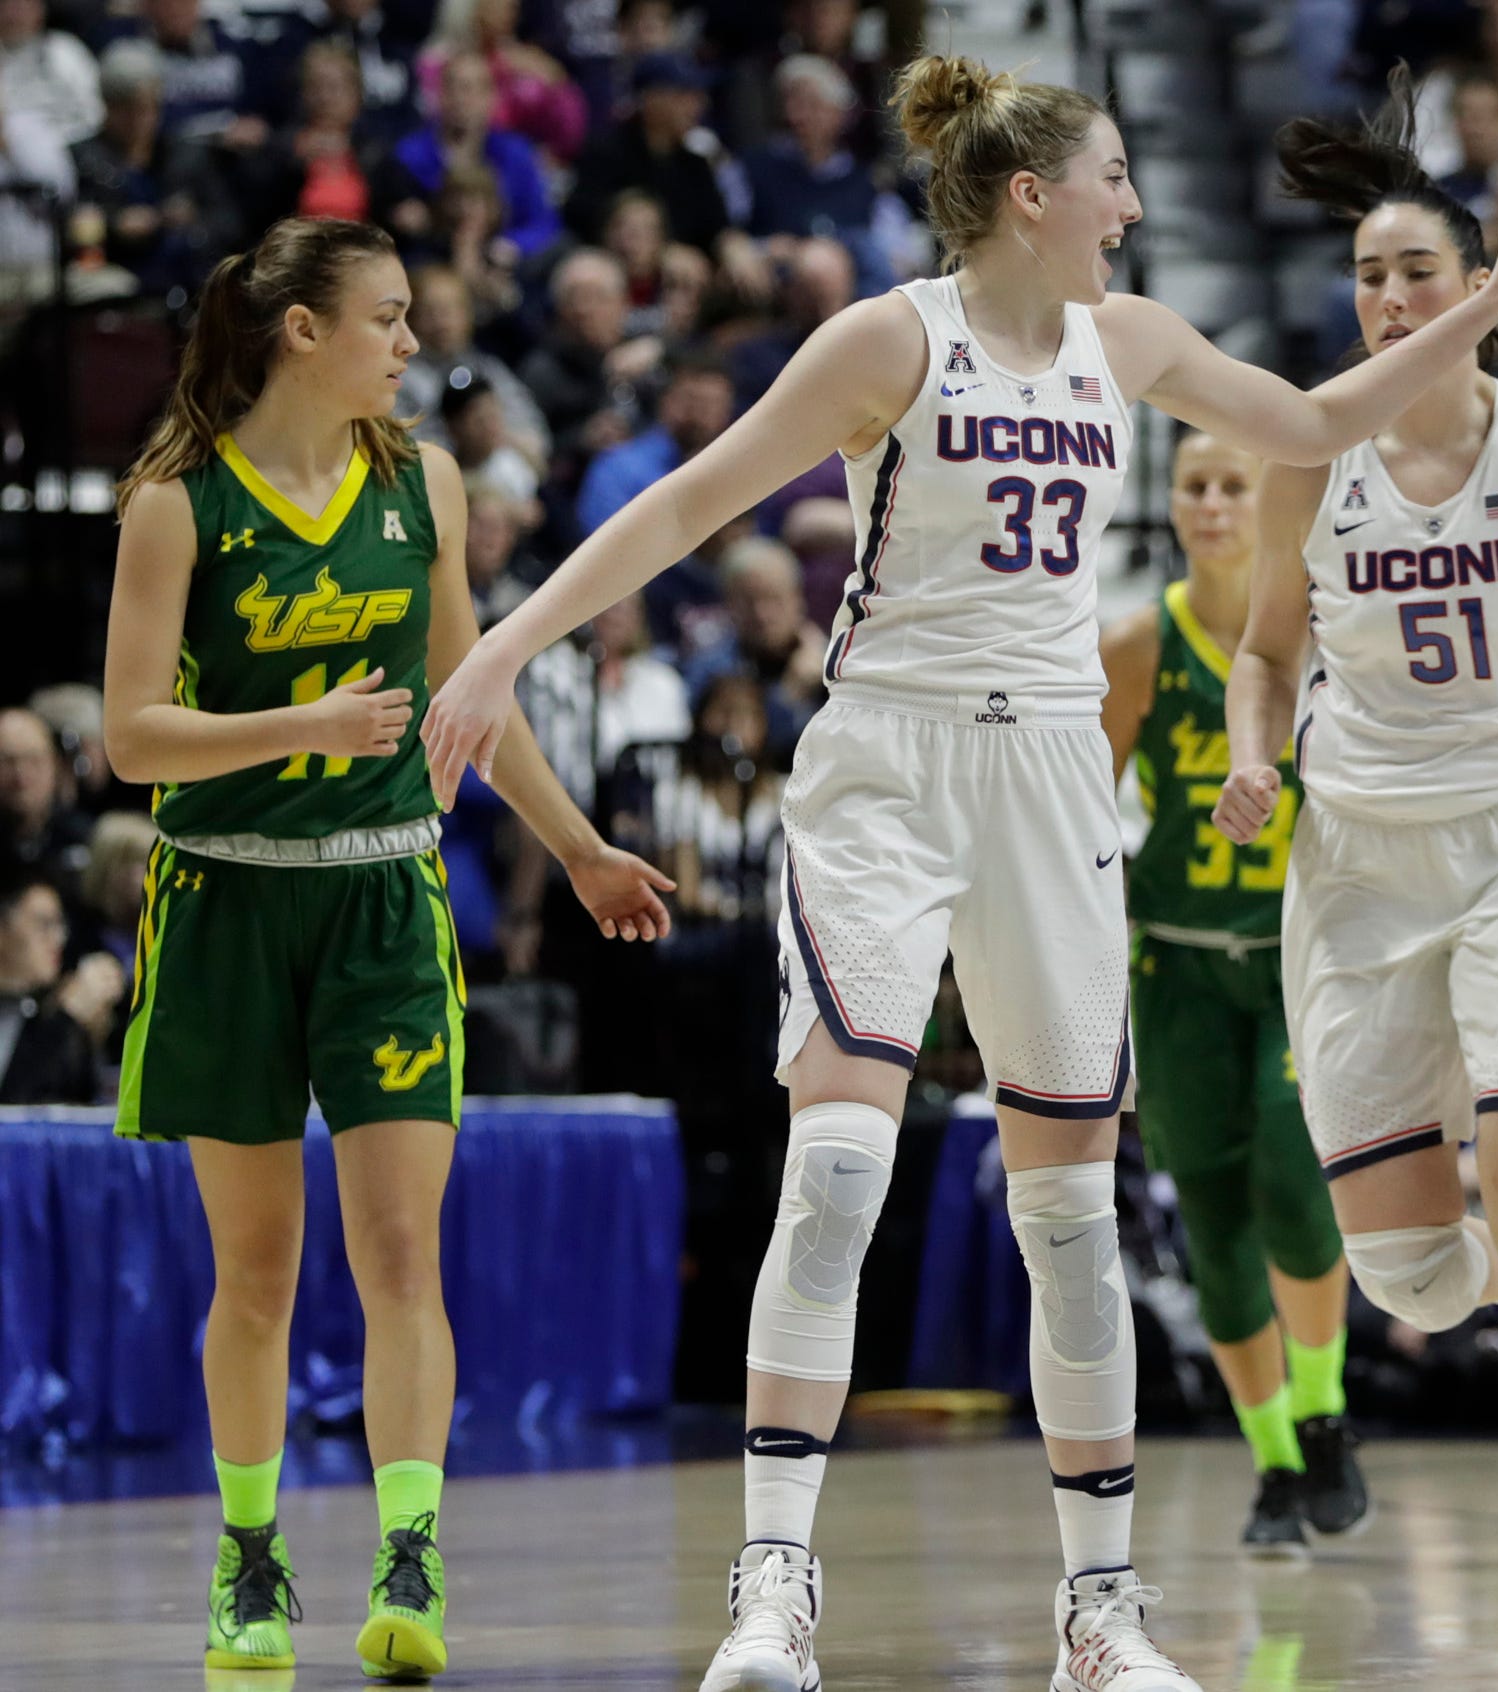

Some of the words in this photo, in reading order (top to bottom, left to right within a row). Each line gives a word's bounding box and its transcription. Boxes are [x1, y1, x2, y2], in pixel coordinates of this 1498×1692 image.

[937, 414, 1117, 470] UCONN
[980, 475, 1088, 577] 33
[234, 565, 413, 653] USF
[1398, 597, 1492, 685] 51
[975, 712, 1017, 725] UCONN
[1186, 783, 1299, 891] 33
